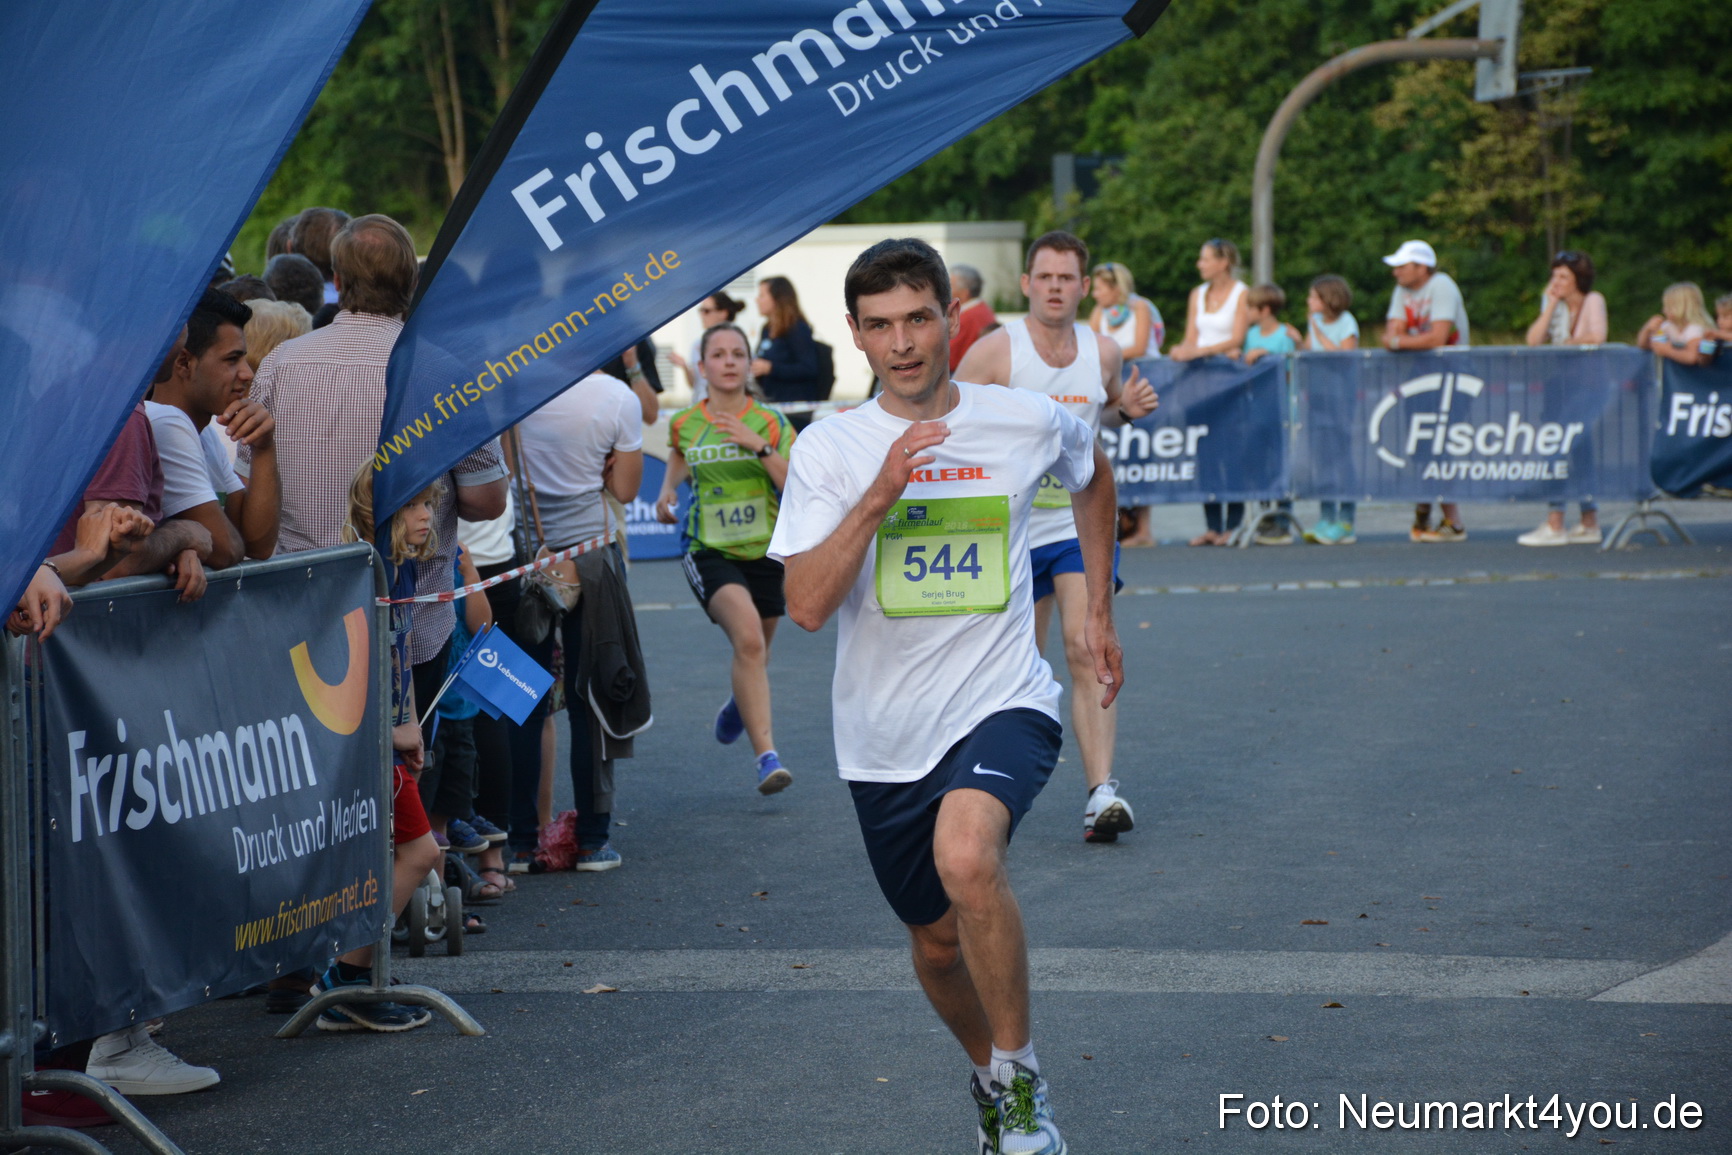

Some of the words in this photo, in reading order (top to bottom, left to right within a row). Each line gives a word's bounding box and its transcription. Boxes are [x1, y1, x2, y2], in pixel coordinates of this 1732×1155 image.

[827, 34, 944, 117] Druck
[945, 0, 1024, 45] und
[511, 0, 965, 252] Frischman
[372, 250, 682, 472] www.frischmann-net.de
[1406, 411, 1584, 456] Fischer
[908, 466, 992, 483] KLEBL
[1423, 460, 1570, 481] AUTOMOBILE
[715, 504, 756, 528] 149
[903, 542, 983, 582] 544
[921, 590, 944, 600] Serjej
[946, 590, 965, 599] Brug
[498, 663, 539, 701] Lebenshilfe
[67, 709, 317, 843] Frischmann
[232, 813, 288, 874] Druck
[288, 801, 326, 859] und
[331, 788, 378, 846] Medien
[235, 869, 379, 952] www.frischmann-net.de
